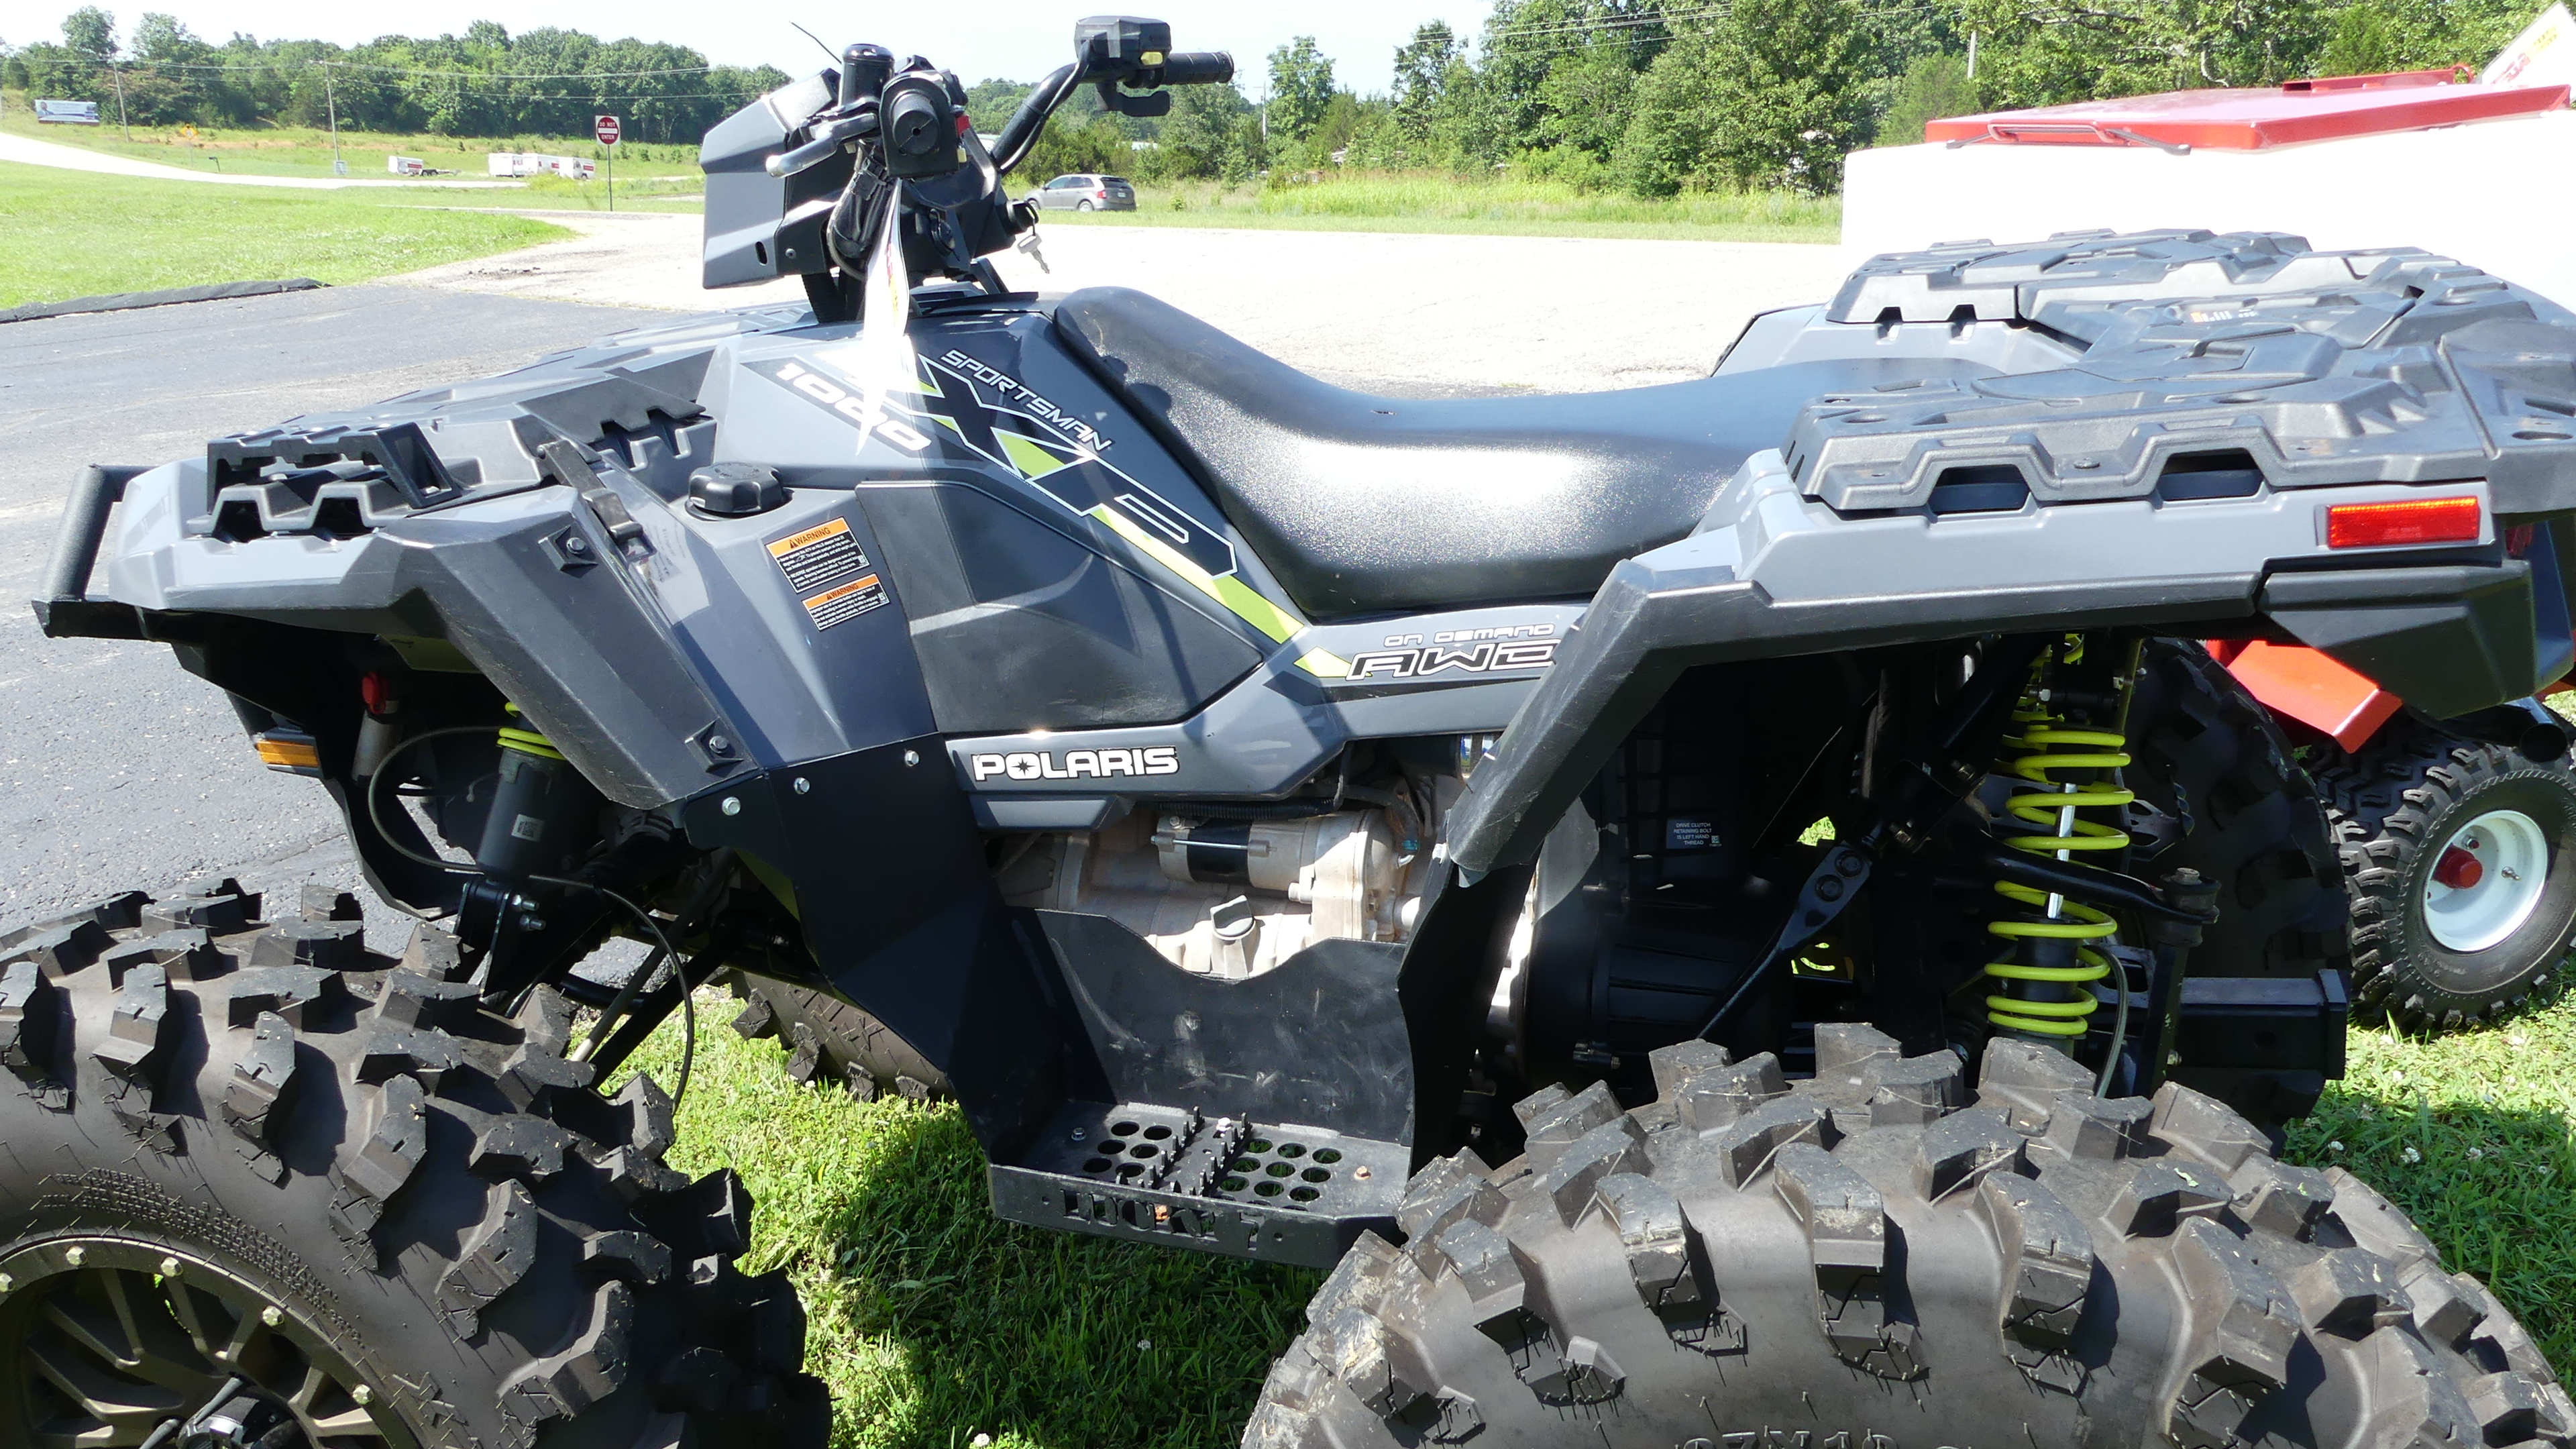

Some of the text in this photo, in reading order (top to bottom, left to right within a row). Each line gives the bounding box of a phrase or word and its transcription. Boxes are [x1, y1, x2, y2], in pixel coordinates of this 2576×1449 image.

[941, 350, 1113, 451] SPORTSMAN
[796, 527, 831, 545] WARNING
[831, 583, 859, 600] WARNING
[1434, 623, 1556, 644] DEMAND
[1345, 638, 1562, 681] AWD
[971, 745, 1180, 782] POLARIS
